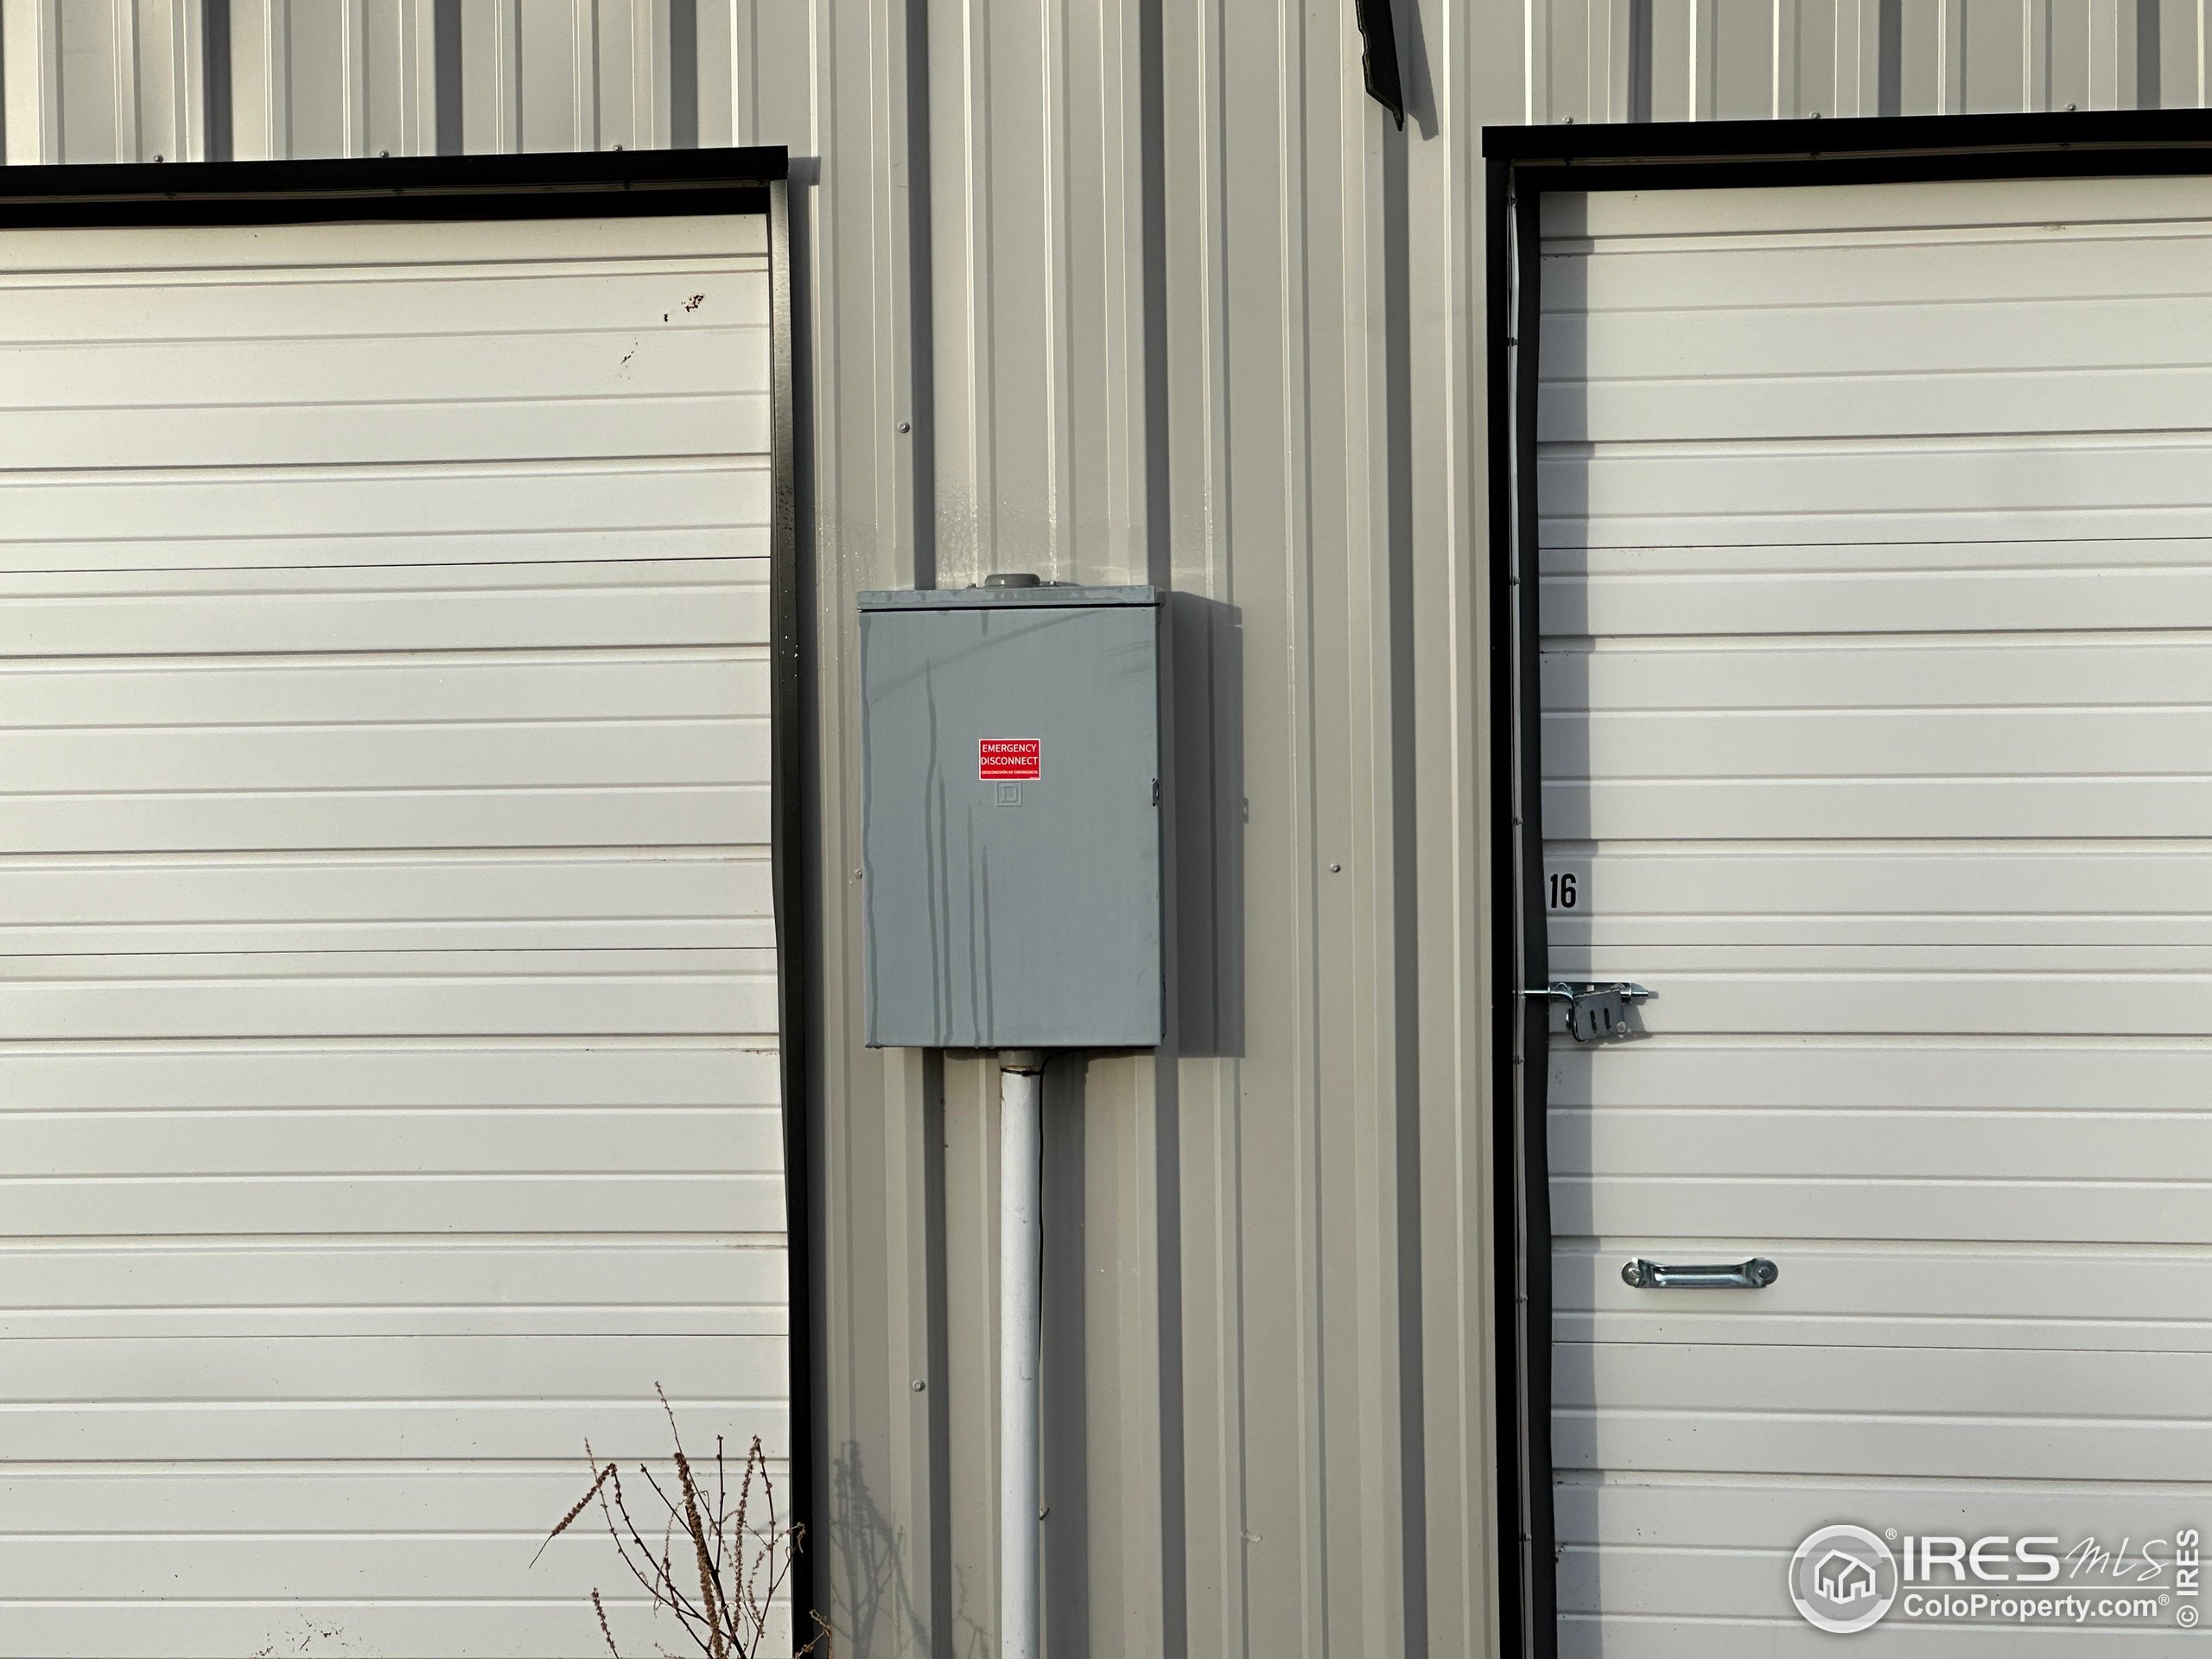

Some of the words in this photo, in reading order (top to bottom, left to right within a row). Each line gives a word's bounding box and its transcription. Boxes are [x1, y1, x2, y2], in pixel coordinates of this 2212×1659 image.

[982, 744, 1037, 753] EMERGENCY
[981, 756, 1039, 766] DISCONNECT
[1550, 873, 1577, 908] 16
